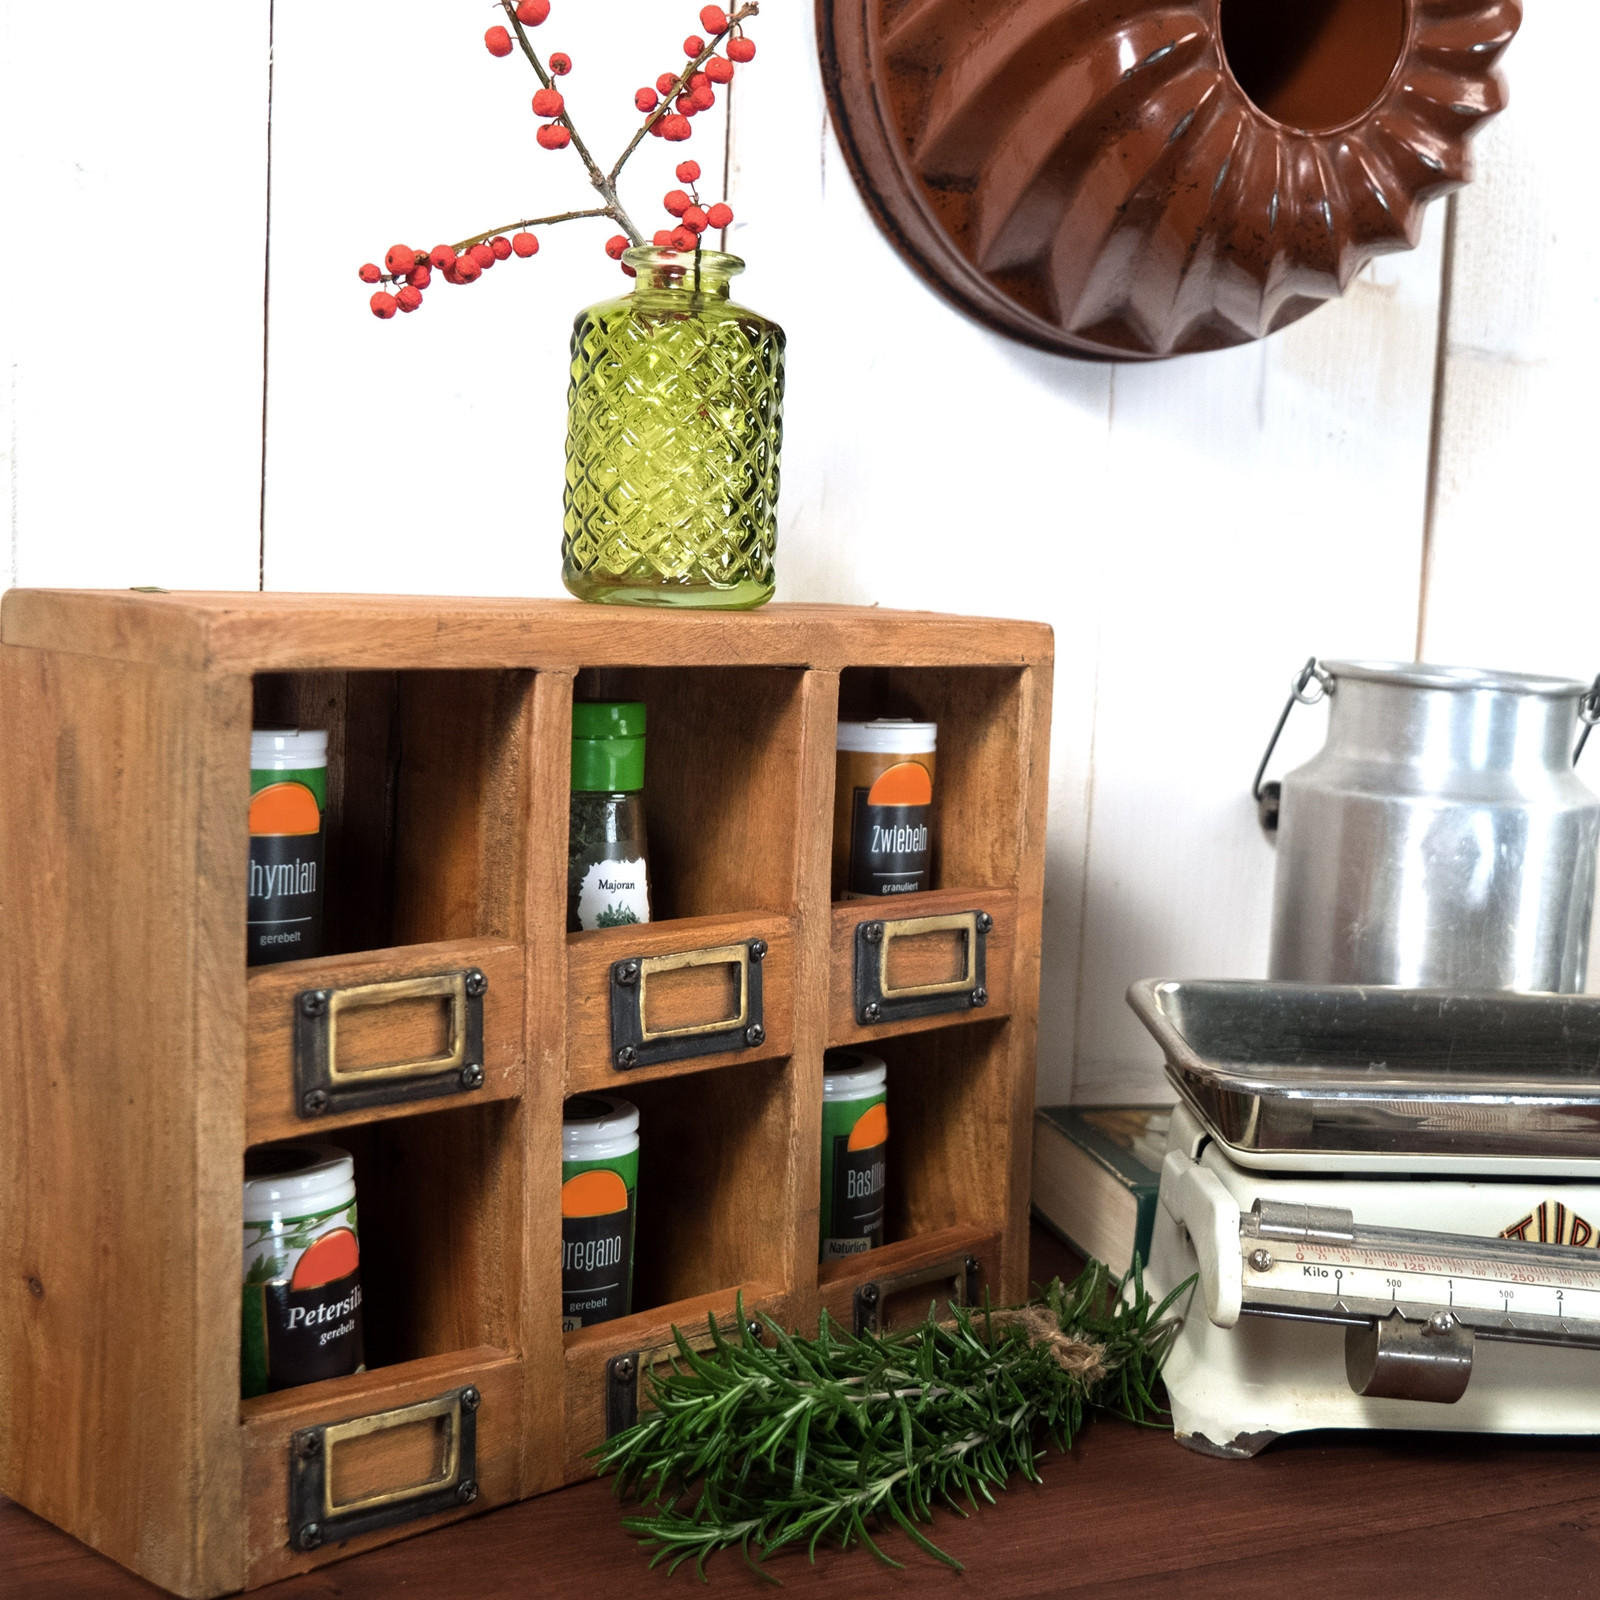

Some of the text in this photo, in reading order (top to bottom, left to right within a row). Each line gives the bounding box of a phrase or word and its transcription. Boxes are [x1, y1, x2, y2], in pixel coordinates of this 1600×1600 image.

[871, 823, 928, 853] Zwiebeln
[250, 858, 317, 900] hymian
[598, 879, 635, 894] Majoran
[882, 882, 919, 894] granuliert
[260, 931, 302, 946] gerebelt
[562, 1235, 622, 1272] regano
[1303, 1266, 1329, 1278] Kilo
[1334, 1269, 1343, 1280] 0
[1386, 1278, 1402, 1288] 500
[1499, 1290, 1514, 1299] 500
[1556, 1289, 1564, 1300] 2
[1383, 1260, 1398, 1268] 100
[1403, 1263, 1426, 1272] 125
[1510, 1273, 1535, 1283] 250
[287, 1284, 362, 1330] Petersili
[570, 1297, 608, 1313] gerebelt
[320, 1319, 355, 1346] gerebelt
